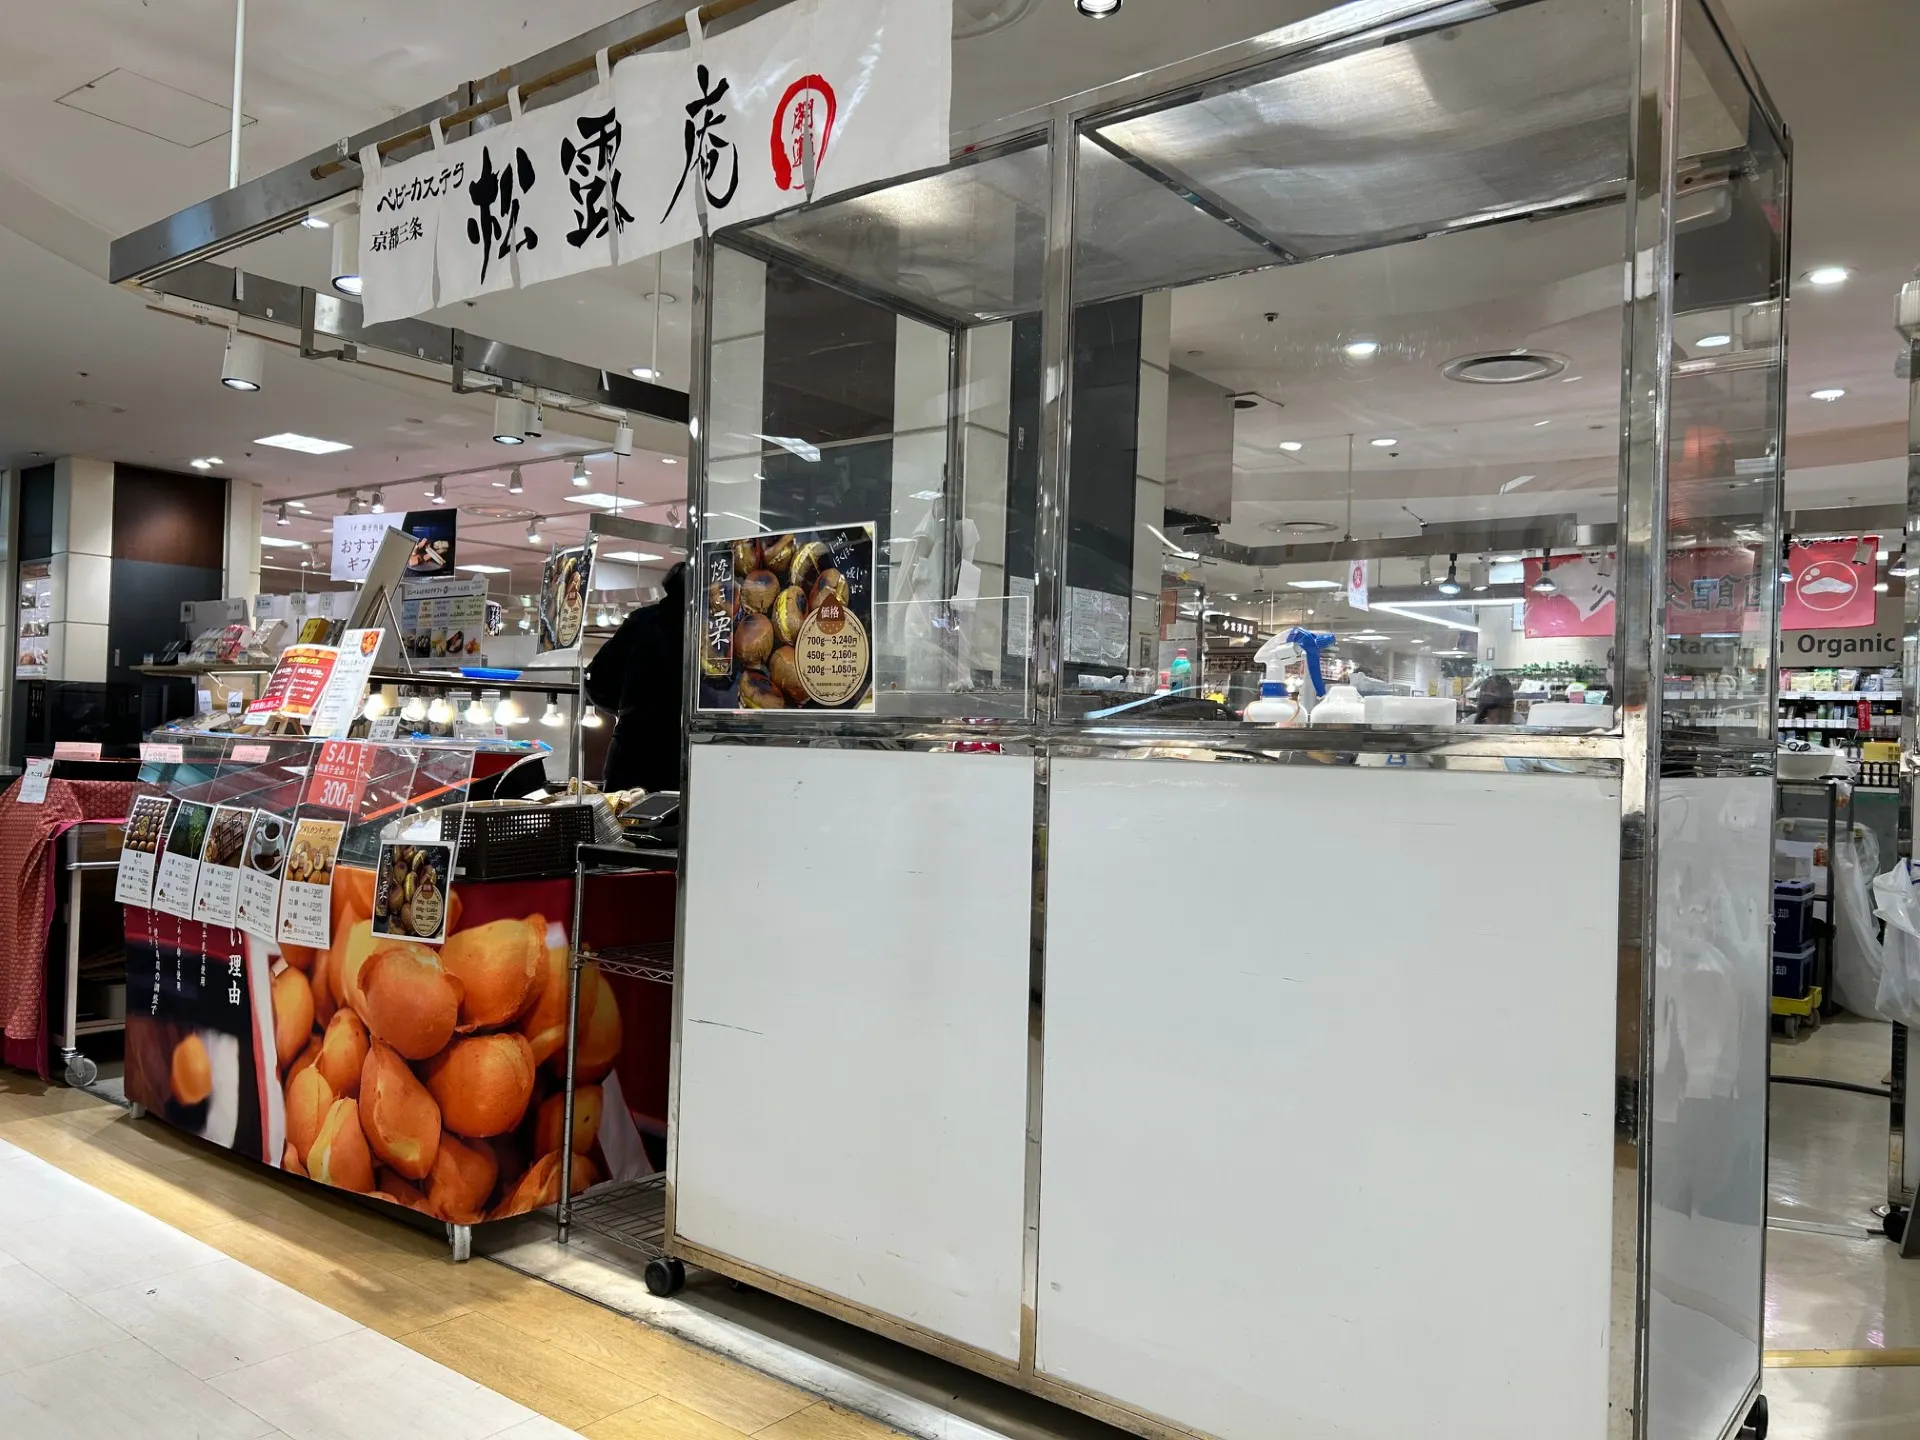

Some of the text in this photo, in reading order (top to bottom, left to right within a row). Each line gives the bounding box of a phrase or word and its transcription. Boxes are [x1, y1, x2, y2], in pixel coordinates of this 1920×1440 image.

[467, 64, 739, 286] 松露庵
[376, 161, 465, 213] ベビーカステラ
[369, 216, 424, 252] 京都三条
[820, 605, 840, 619] 価格
[807, 635, 858, 648] 700g 3,240円
[1797, 633, 1896, 657] Organic
[806, 650, 858, 662] 450g 2,160円
[807, 664, 857, 677] 200g 1,080円
